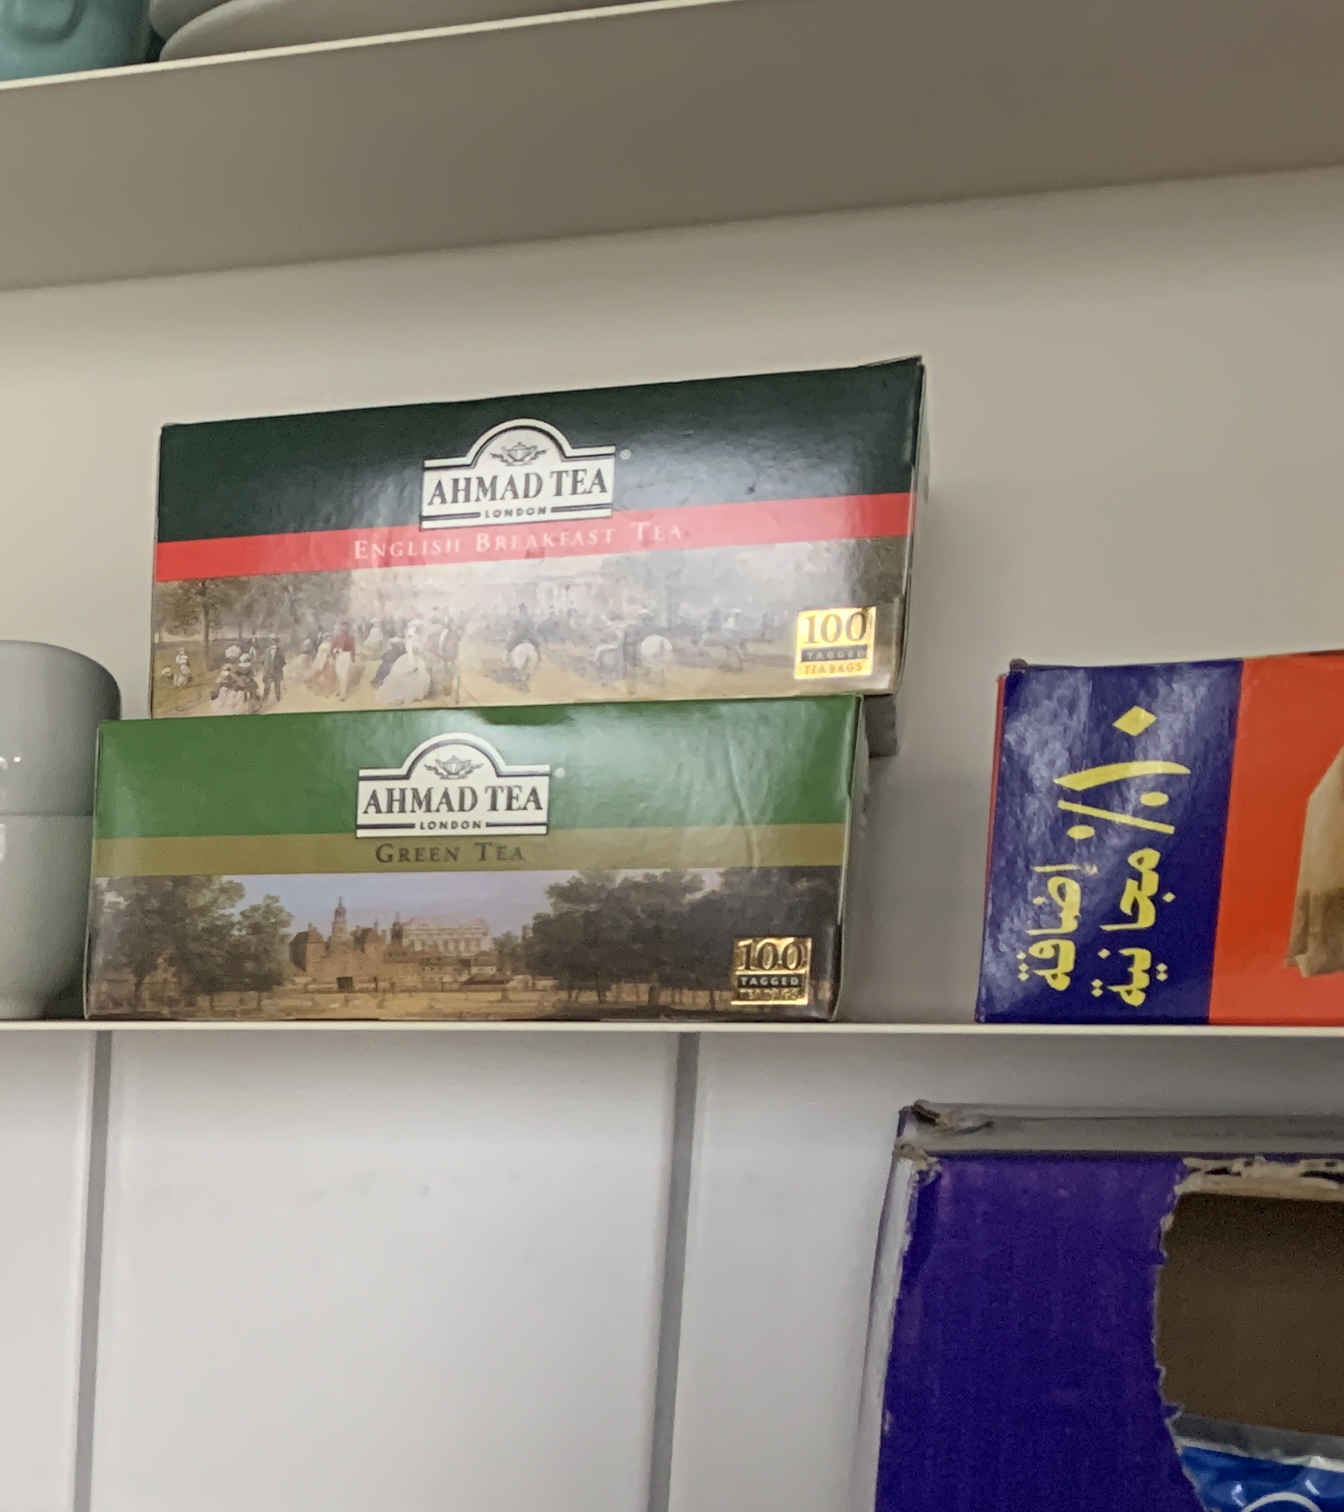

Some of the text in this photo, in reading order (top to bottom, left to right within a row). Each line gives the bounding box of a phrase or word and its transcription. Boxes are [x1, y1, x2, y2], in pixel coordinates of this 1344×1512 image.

[427, 467, 609, 506] AHMAD TEA
[484, 506, 547, 519] LONDON
[803, 611, 867, 644] 100
[806, 649, 867, 660] TAGGED
[362, 785, 544, 815] AHMAD TEA
[419, 820, 482, 830] LONDON
[375, 842, 526, 864] GREEN TEA
[737, 939, 803, 970] 100
[740, 977, 799, 986] TAGGED
